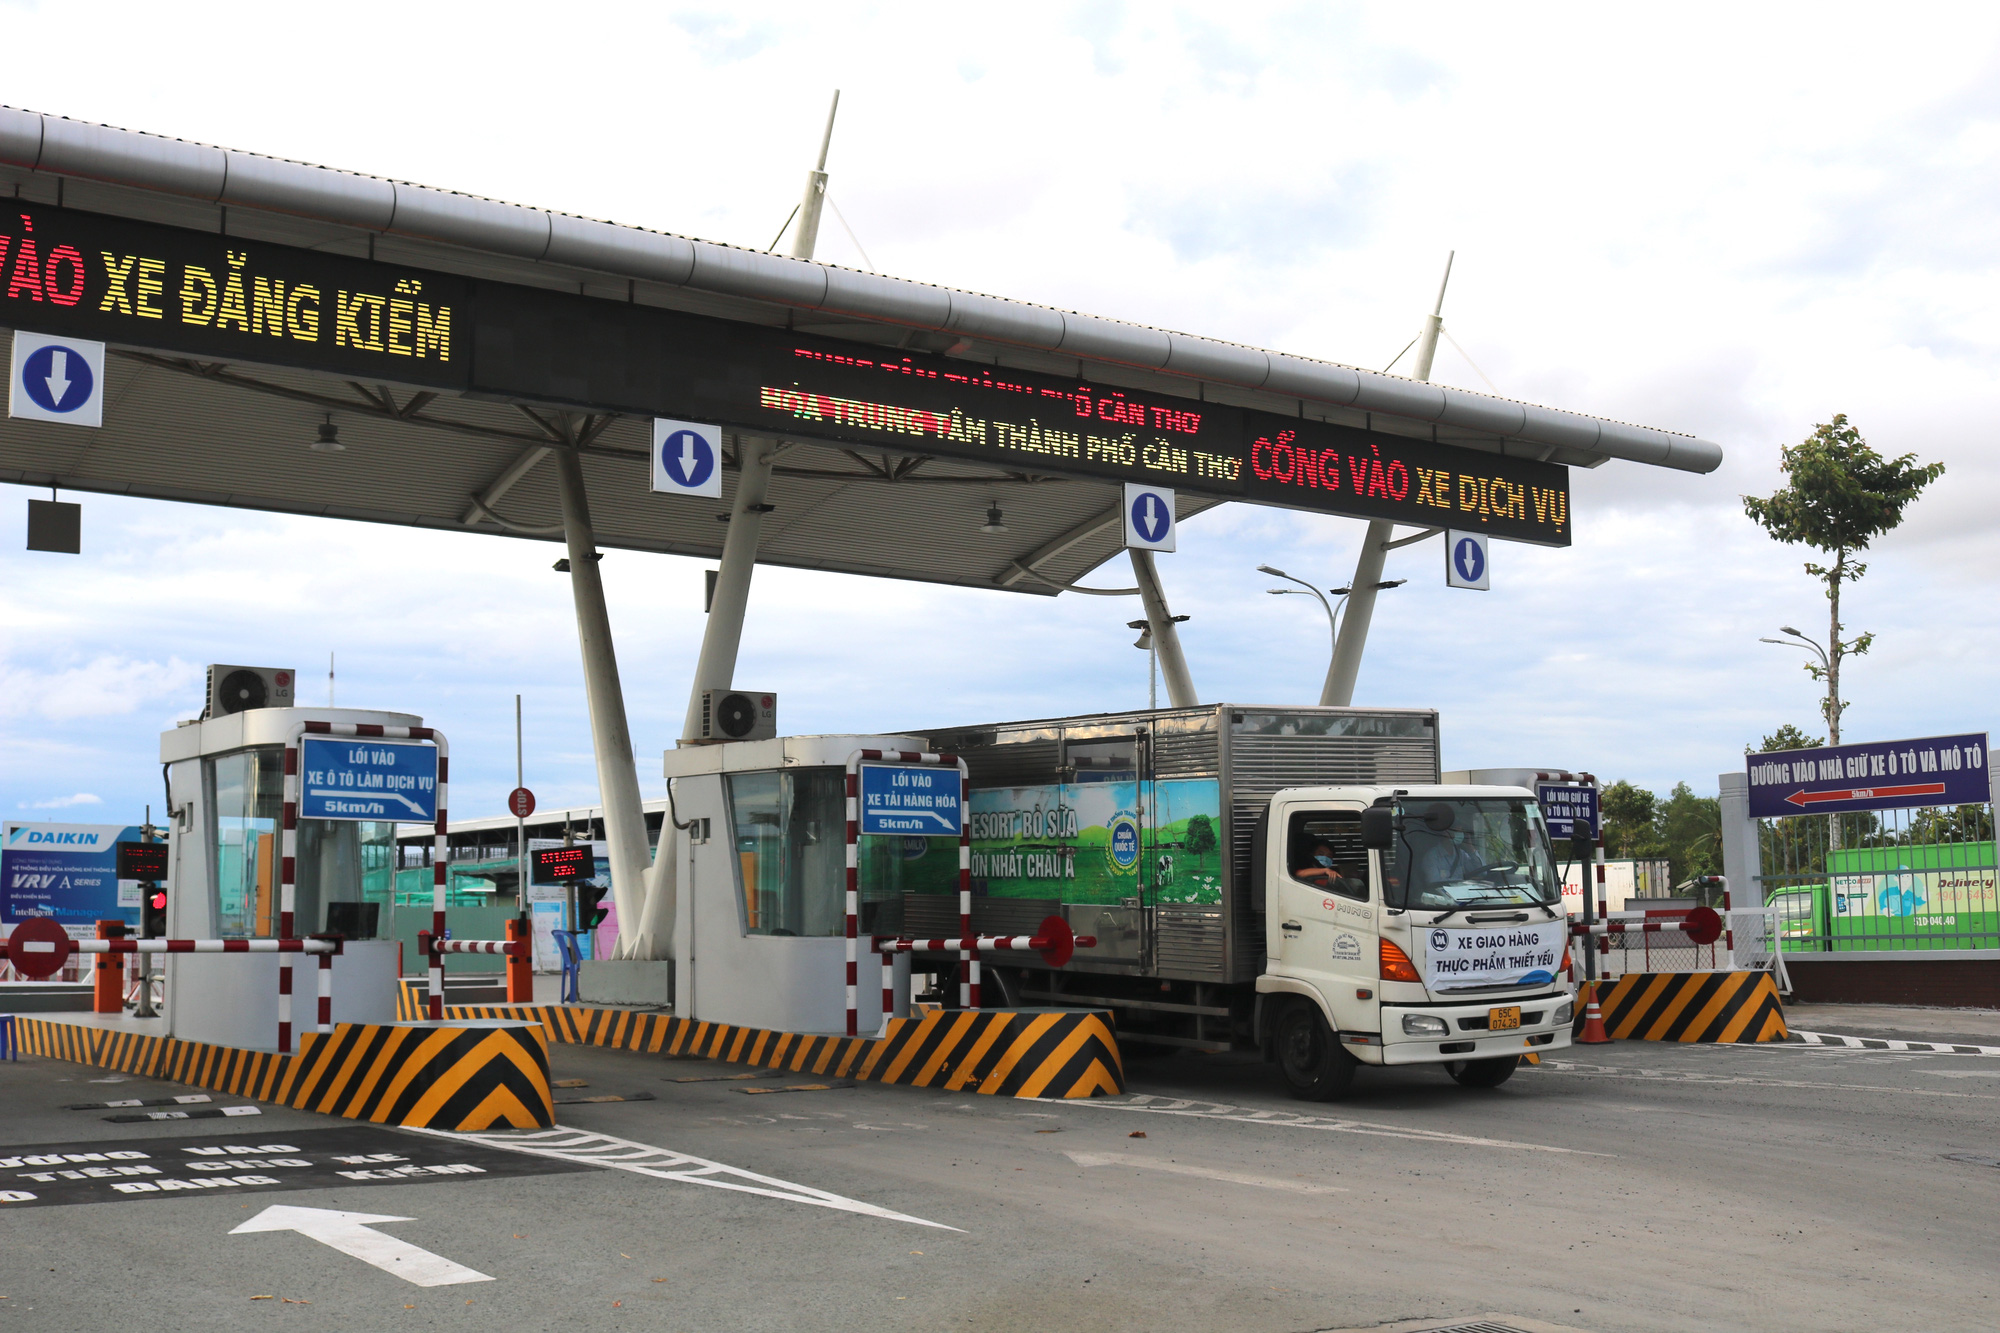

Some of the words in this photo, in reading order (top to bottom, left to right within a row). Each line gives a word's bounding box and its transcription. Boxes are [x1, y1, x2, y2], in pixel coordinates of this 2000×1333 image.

[100, 251, 165, 319] XE
[179, 250, 320, 342] ĐĂNG
[829, 397, 924, 435] TRUNG
[932, 407, 986, 445] TÂM
[993, 418, 1079, 458] THÀNH
[1087, 432, 1137, 465] PHỐ
[1142, 437, 1187, 473] CẦN
[1193, 451, 1242, 480] THƠ
[1251, 430, 1340, 491] CỔNG
[1348, 444, 1409, 501] VÀO
[1416, 467, 1451, 509] XE
[1459, 474, 1525, 522] DỊCH
[1532, 487, 1565, 533] VỤ
[349, 746, 368, 764] LỐI
[372, 749, 395, 766] VÀO
[1750, 762, 1789, 786] ĐƯỜNG
[1792, 758, 1816, 783] VÀO
[1819, 755, 1844, 781] NHÀ
[1846, 753, 1868, 779] GIỮ
[1871, 754, 1886, 776] XE
[1888, 750, 1898, 775] Ô
[1900, 748, 1917, 774] TÔ
[1919, 747, 1938, 772] VÀ
[1940, 744, 1961, 771] MÔ
[1964, 742, 1982, 769] TÔ
[308, 770, 323, 786] XE
[327, 769, 336, 786] Ô
[339, 770, 353, 787] TÔ
[357, 770, 383, 788] LÀM
[386, 774, 414, 792] DỊCH
[418, 776, 434, 794] VỤ
[892, 771, 908, 787] LỐI
[911, 773, 932, 788] VÀO
[867, 793, 881, 806] XE
[884, 791, 900, 807] TẢI
[903, 792, 932, 807] HÀNG
[935, 793, 957, 808] HÓA
[1582, 793, 1590, 803] XE
[1851, 789, 1874, 798] 5km/h
[325, 801, 384, 815] 5km/h
[517, 790, 527, 816] STOP
[1553, 804, 1561, 817] TÔ
[1562, 805, 1570, 817] VÀ
[1582, 805, 1590, 818] TÔ
[879, 818, 923, 829] 5km/h
[1022, 803, 1043, 838] BÒ
[1046, 804, 1079, 838] SỮA
[28, 831, 99, 845] DAIKIN
[970, 850, 988, 877] ỚN
[992, 846, 1023, 877] NHẤT
[1027, 850, 1061, 878] CHÂU
[11, 873, 57, 889] VRV
[58, 875, 72, 889] A
[74, 878, 102, 887] SERIES
[1937, 879, 1994, 888] Delivery
[11, 904, 54, 918] intelligent
[1337, 903, 1372, 920] HINO
[1458, 937, 1472, 950] XE
[1476, 935, 1506, 948] GIAO
[1509, 931, 1539, 946] HÀNG
[1436, 958, 1469, 975] THỰC
[1472, 951, 1506, 970] PHẨM
[1508, 950, 1535, 968] THIẾT
[1537, 949, 1554, 966] YẾU
[1498, 1009, 1512, 1019] 65C
[1492, 1018, 1517, 1029] 074.29
[185, 1158, 314, 1171] CHO
[330, 1153, 410, 1164] XE
